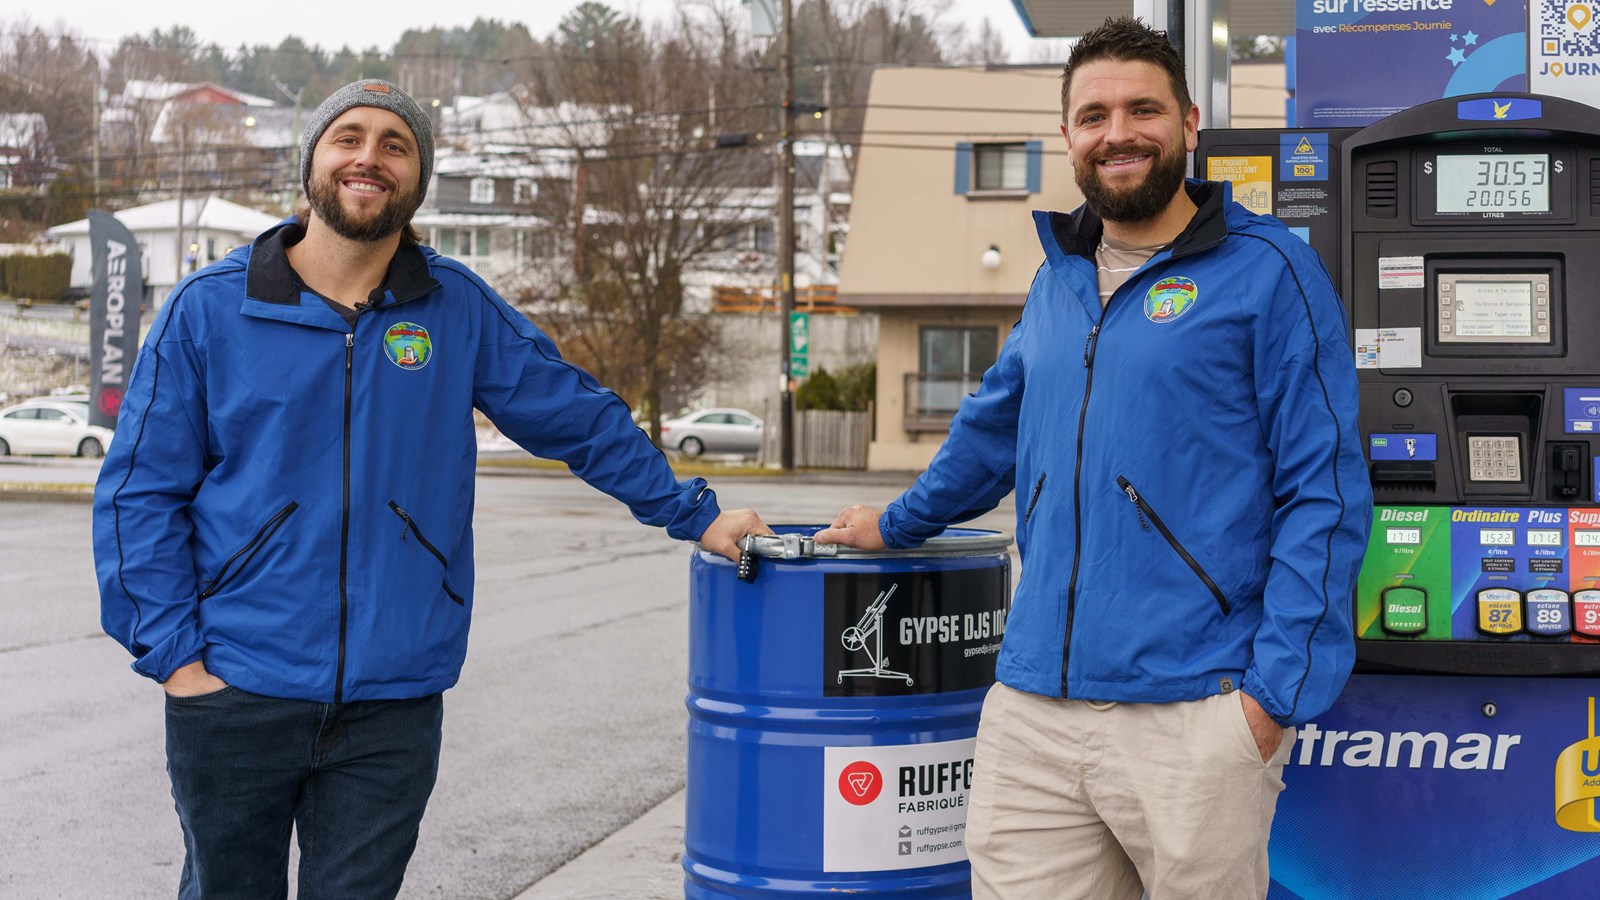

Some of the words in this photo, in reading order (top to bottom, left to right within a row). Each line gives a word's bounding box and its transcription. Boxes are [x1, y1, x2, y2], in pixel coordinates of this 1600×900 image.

[1313, 25, 1336, 34] avec
[1338, 22, 1411, 34] Récompenses
[1413, 20, 1451, 30] Journie
[1424, 161, 1433, 174] $
[1477, 161, 1546, 185] 30.53
[1554, 160, 1563, 173] $
[1466, 190, 1530, 206] 20.056
[102, 240, 127, 384] AEROPLAN
[1380, 509, 1429, 522] Diesel
[1452, 510, 1520, 523] Ordinaire
[1528, 510, 1562, 523] Plus
[1392, 532, 1417, 542] 171.9
[1486, 533, 1511, 543] 152.2
[1534, 534, 1558, 543] 171.2
[1388, 604, 1422, 613] Diesel
[1488, 610, 1512, 622] 87
[1537, 610, 1562, 623] 89
[1584, 610, 1600, 624] 9
[900, 615, 960, 645] GYPSE
[964, 612, 990, 640] DJS
[1285, 724, 1521, 770] tramar
[899, 758, 974, 797] RUFFG
[898, 793, 964, 813] FABRIQUÉ
[916, 840, 962, 853] ruffgypse.com
